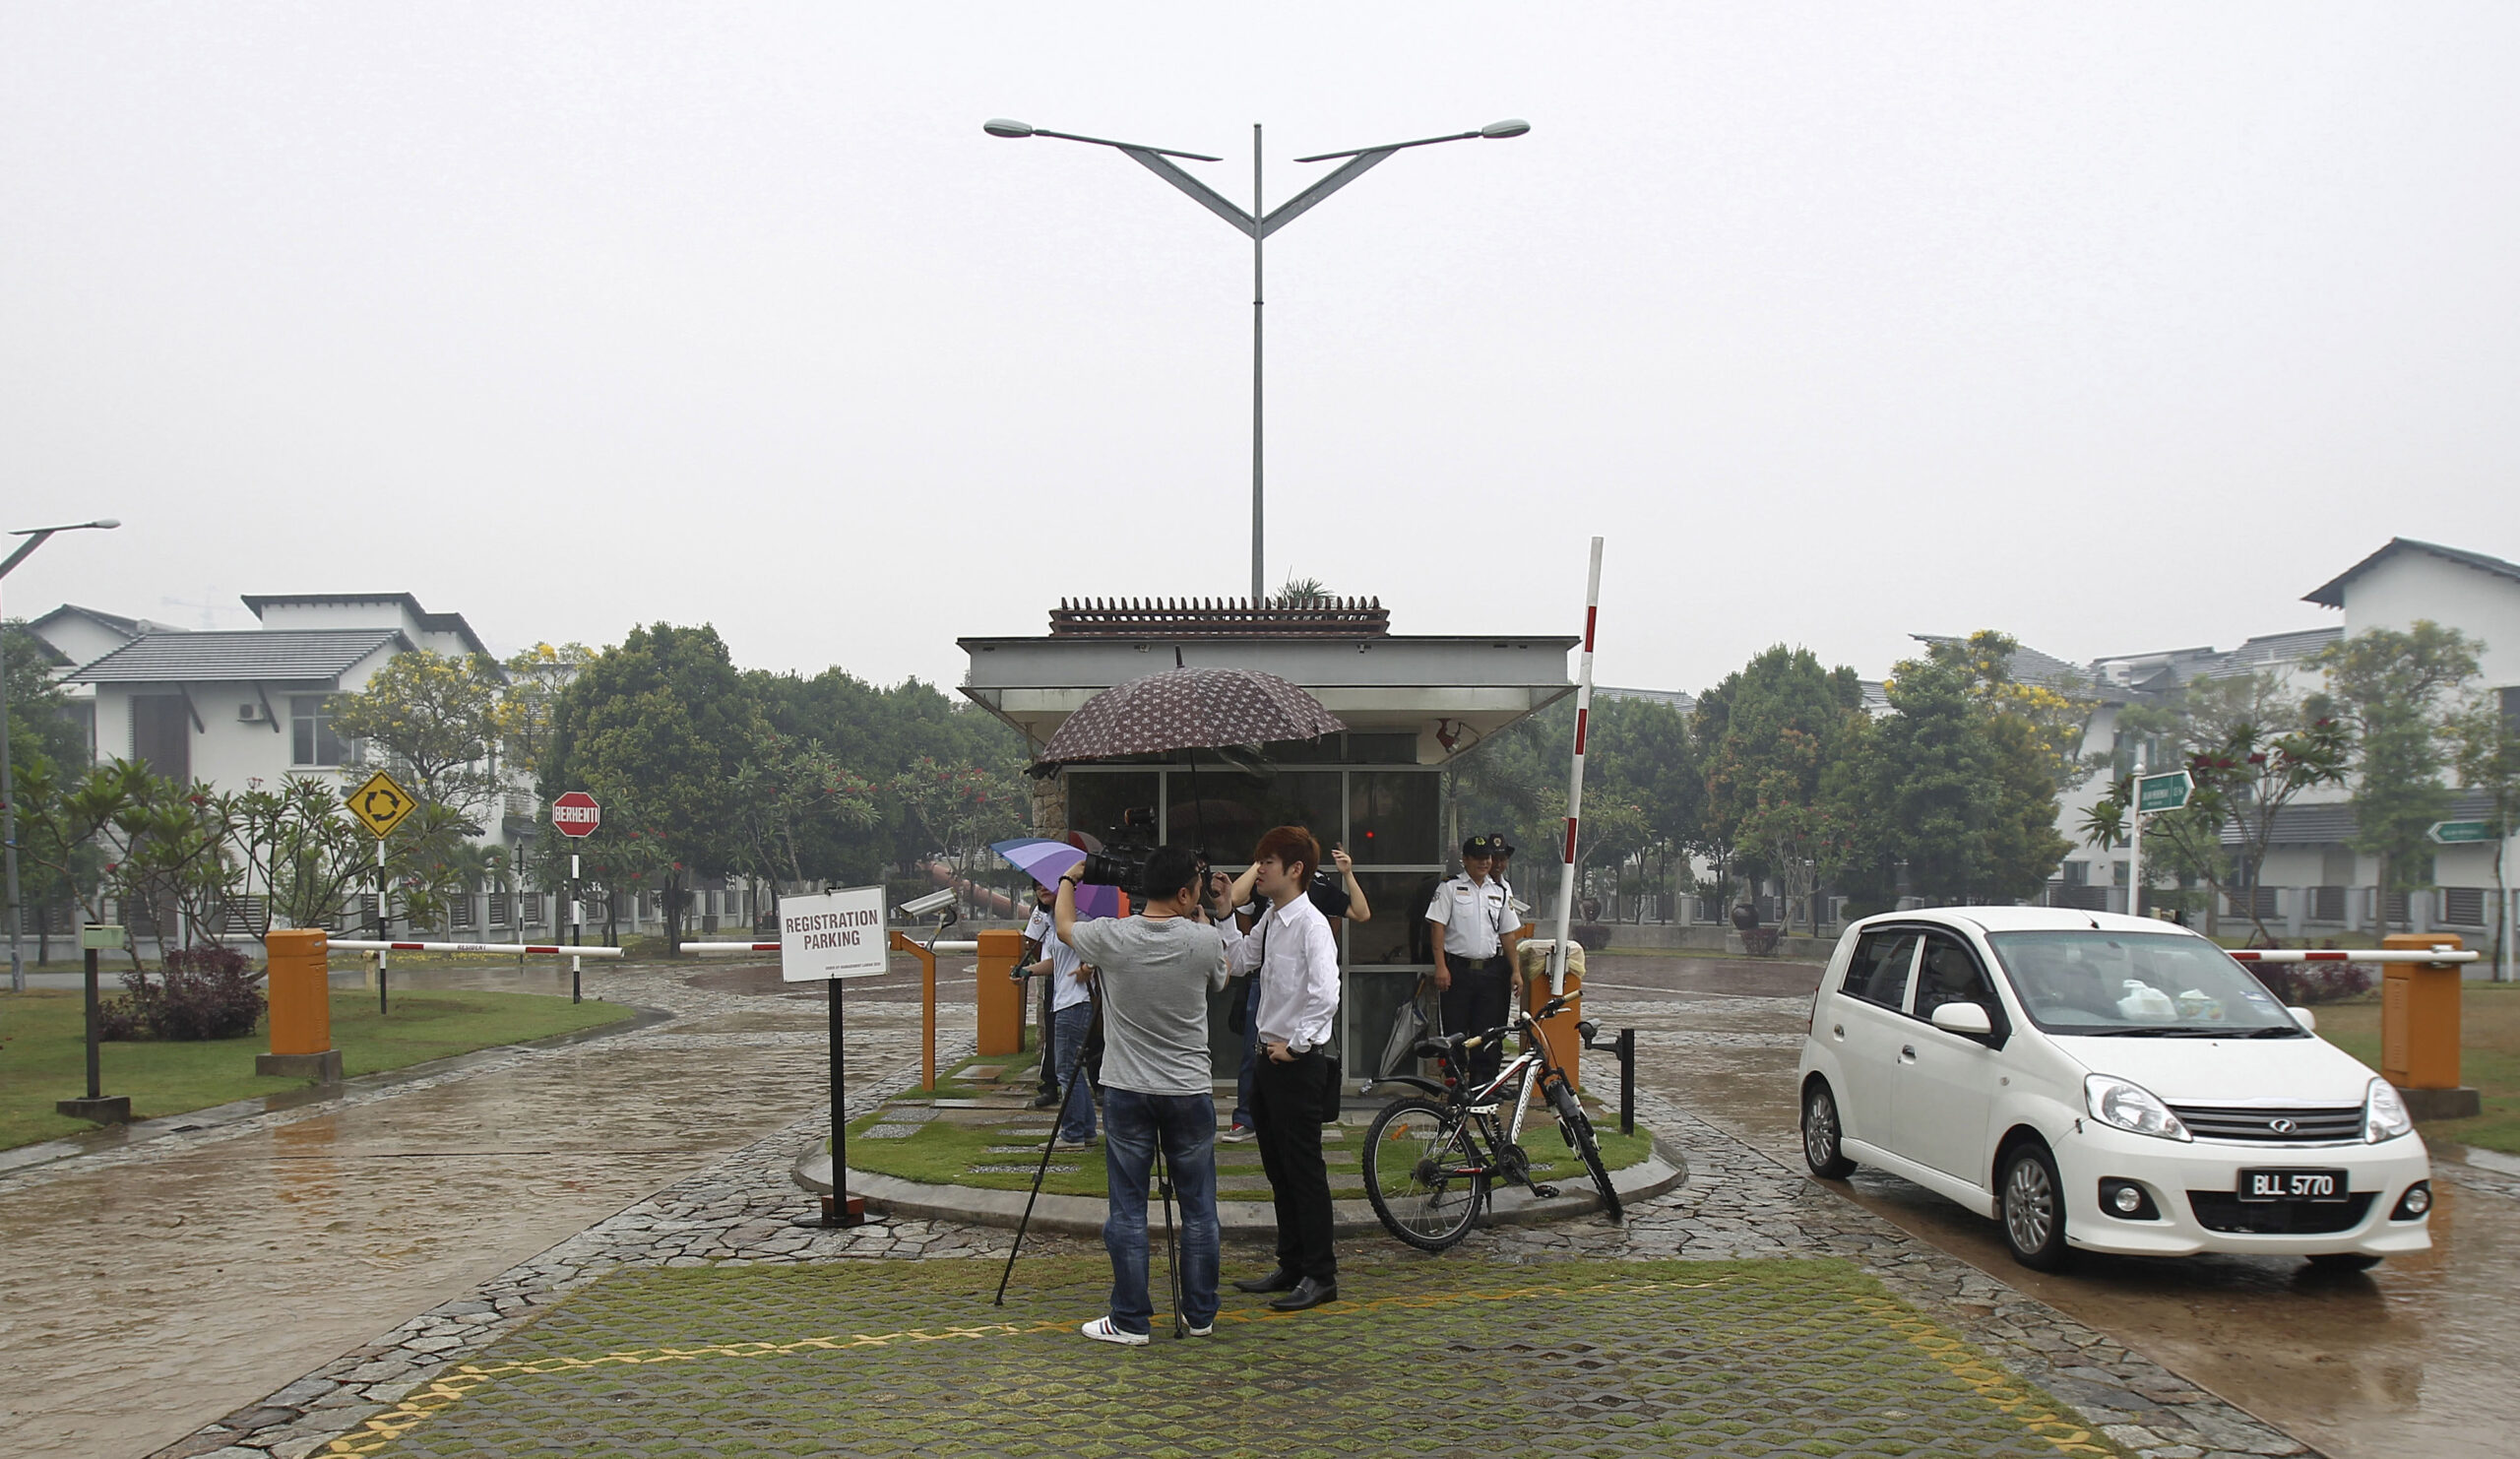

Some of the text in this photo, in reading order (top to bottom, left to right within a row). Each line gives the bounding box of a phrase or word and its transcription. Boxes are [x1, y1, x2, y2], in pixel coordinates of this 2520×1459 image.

[554, 805, 598, 823] BERHENTI
[786, 909, 878, 933] REGISTRATION
[803, 929, 860, 951] PARKING
[2252, 1174, 2333, 1195] BLL 5770
